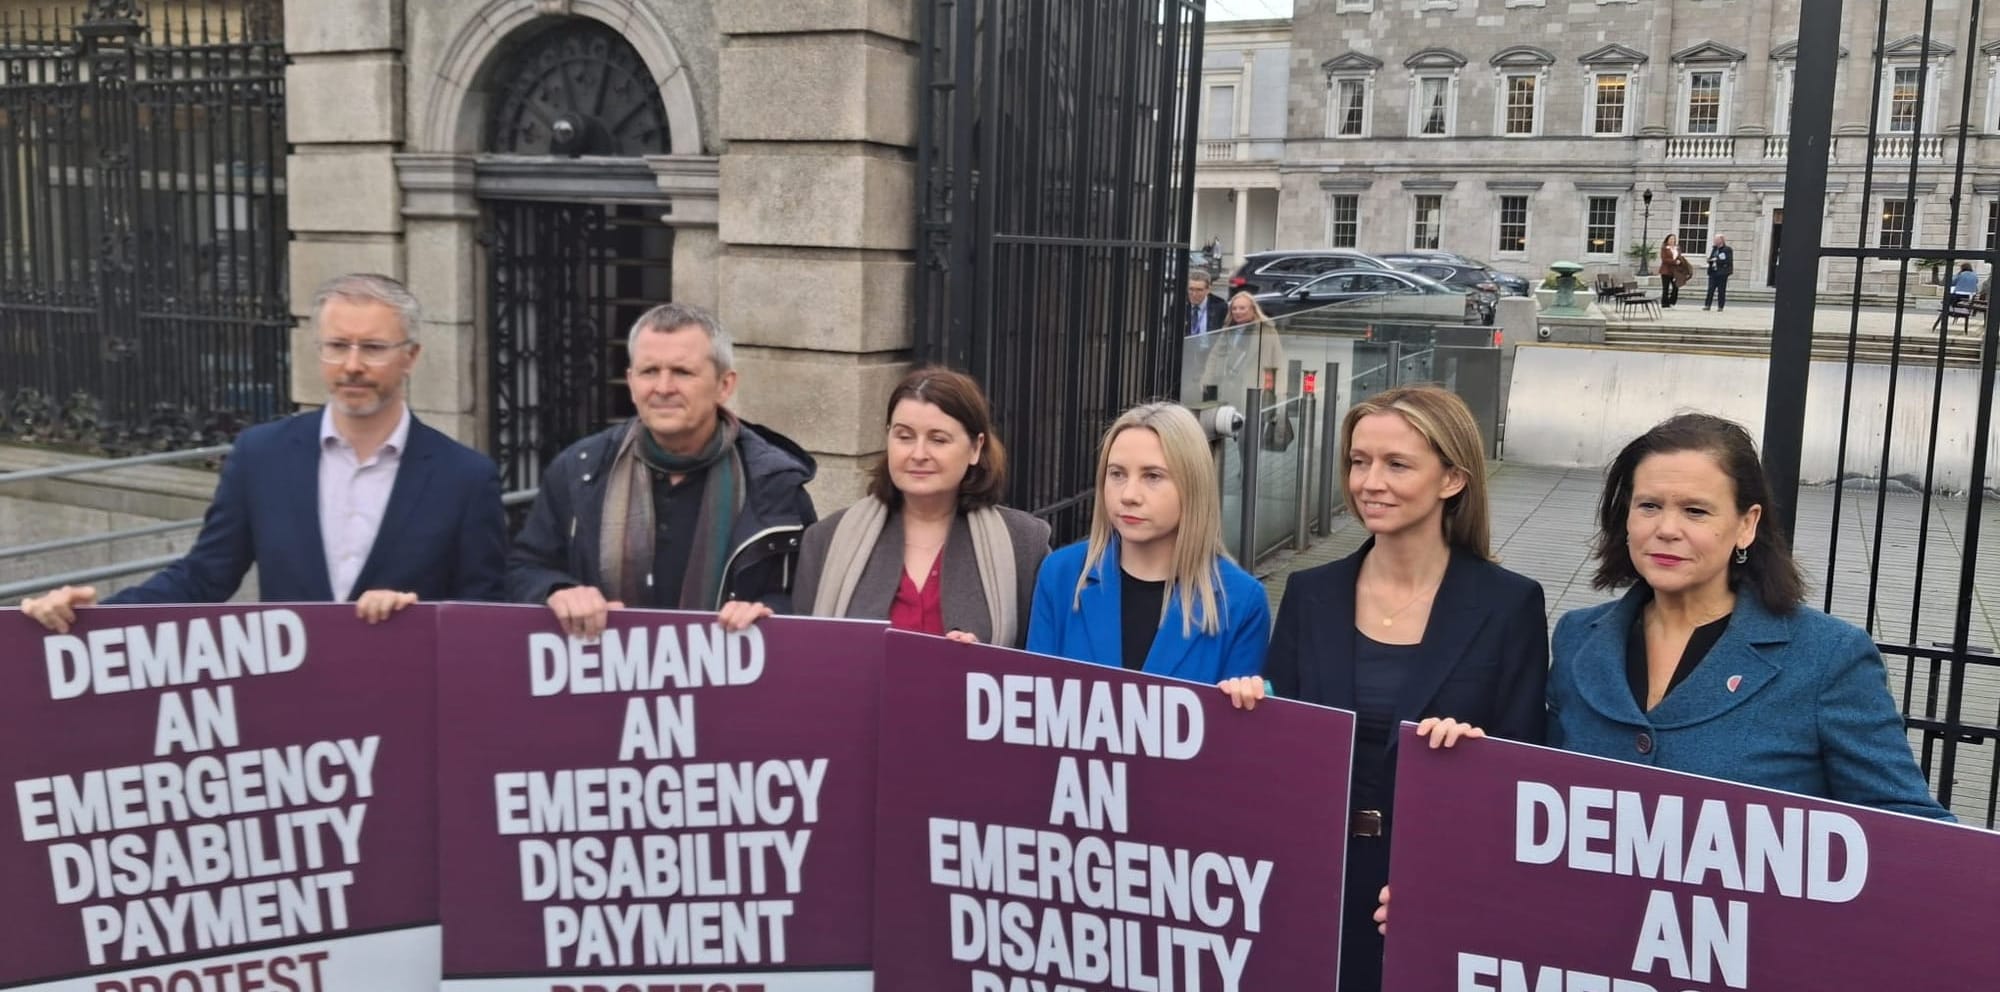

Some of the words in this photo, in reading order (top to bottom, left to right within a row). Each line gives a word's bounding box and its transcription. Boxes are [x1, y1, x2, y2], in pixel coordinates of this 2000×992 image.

[44, 609, 307, 700] DEMAND
[529, 622, 766, 697] DEMAND
[154, 685, 239, 756] AN
[619, 694, 696, 761] AN
[966, 672, 1205, 760] DEMAND
[15, 735, 380, 842] EMERGENCY
[495, 758, 829, 835] EMERGENCY
[1049, 756, 1128, 833] AN
[49, 804, 367, 904] DISABILITY
[519, 829, 811, 901] DISABILITY
[929, 817, 1274, 933] EMERGENCY
[1515, 780, 1869, 903] DEMAND
[82, 871, 354, 965] PAYMENT
[544, 900, 794, 967] PAYMENT
[950, 893, 1252, 992] DISABILITY
[1631, 889, 1748, 989] AN
[96, 951, 329, 992] TEST
